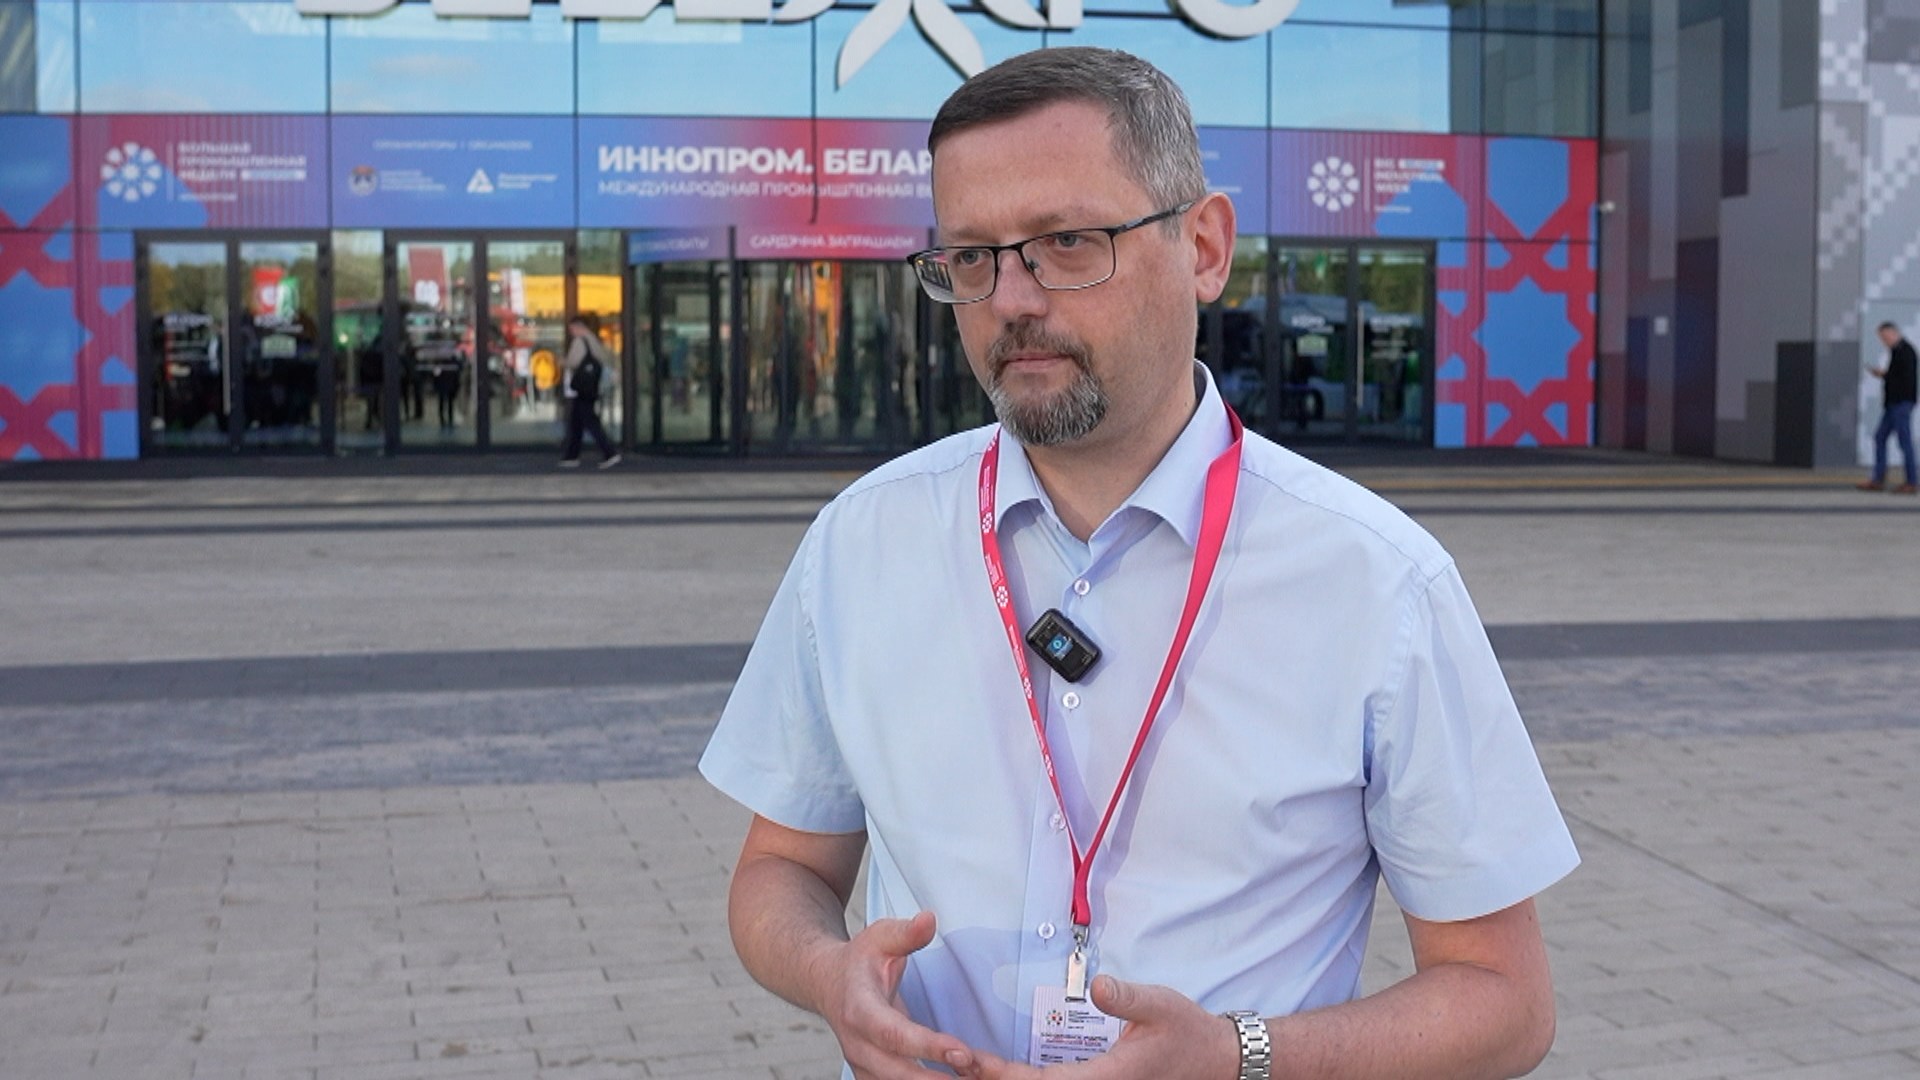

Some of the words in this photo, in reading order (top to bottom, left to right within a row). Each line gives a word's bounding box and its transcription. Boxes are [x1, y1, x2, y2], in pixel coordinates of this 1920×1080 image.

[598, 145, 815, 174] ИННОПРОМ.
[598, 181, 760, 198] МЕЖДУНАРОДНАЯ
[762, 182, 914, 199] ПРОМЫШЛЕННАЯ
